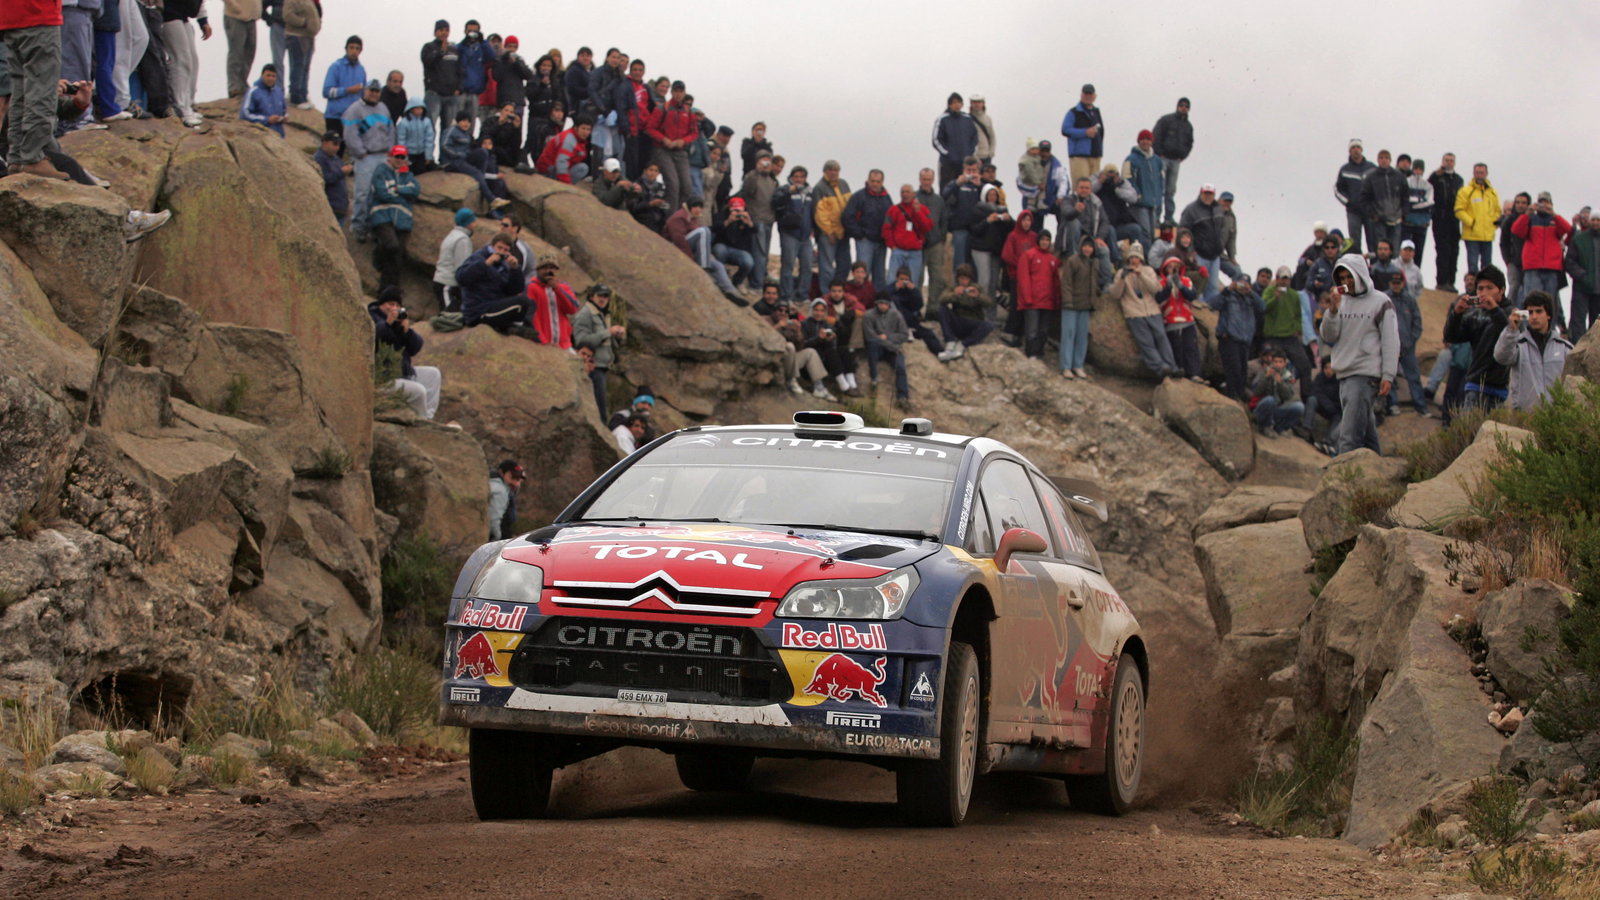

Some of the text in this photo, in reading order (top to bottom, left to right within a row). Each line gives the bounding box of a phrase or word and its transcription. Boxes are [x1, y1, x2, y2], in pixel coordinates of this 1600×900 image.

[589, 544, 763, 570] TOTAL
[458, 601, 528, 631] Red Bull
[782, 623, 887, 650] Red Bull
[451, 687, 480, 702] PIRELLI
[620, 692, 664, 703] 459 EMX 78
[826, 711, 881, 728] PIRELLI
[632, 723, 680, 738] sportif
